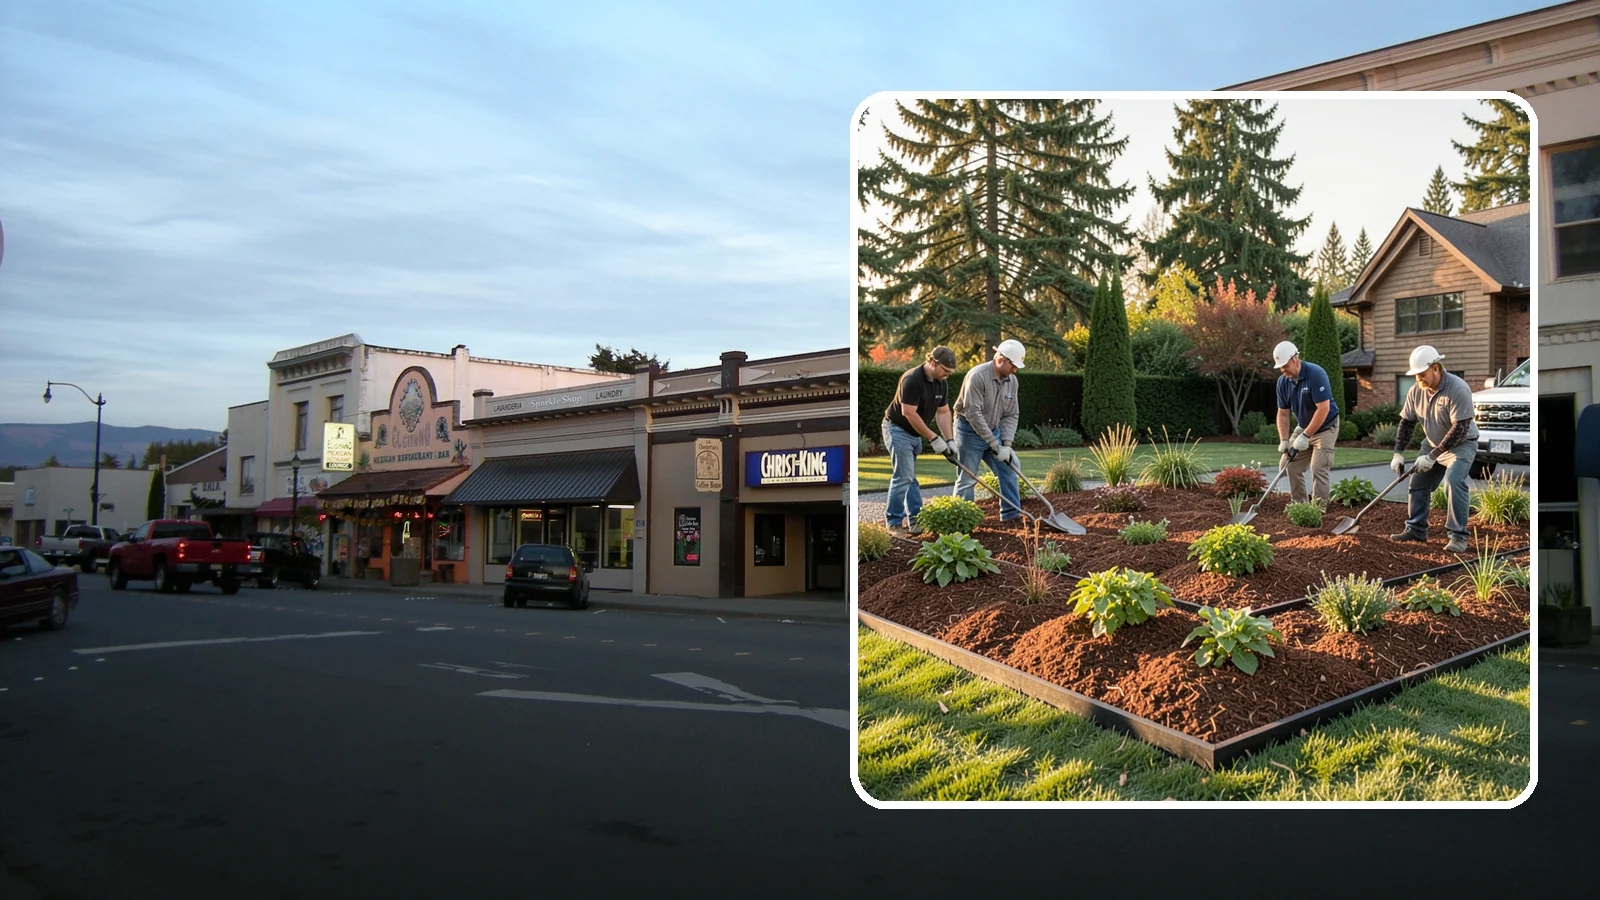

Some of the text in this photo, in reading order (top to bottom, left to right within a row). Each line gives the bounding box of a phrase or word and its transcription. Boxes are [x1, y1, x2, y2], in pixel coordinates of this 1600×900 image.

[494, 402, 522, 412] LAVANDERIA
[596, 389, 623, 400] LAUNDRY
[374, 455, 396, 464] MEXICAN
[398, 452, 433, 462] RESTAURANT
[438, 450, 450, 458] BAR
[760, 450, 827, 478] CHRIST KING
